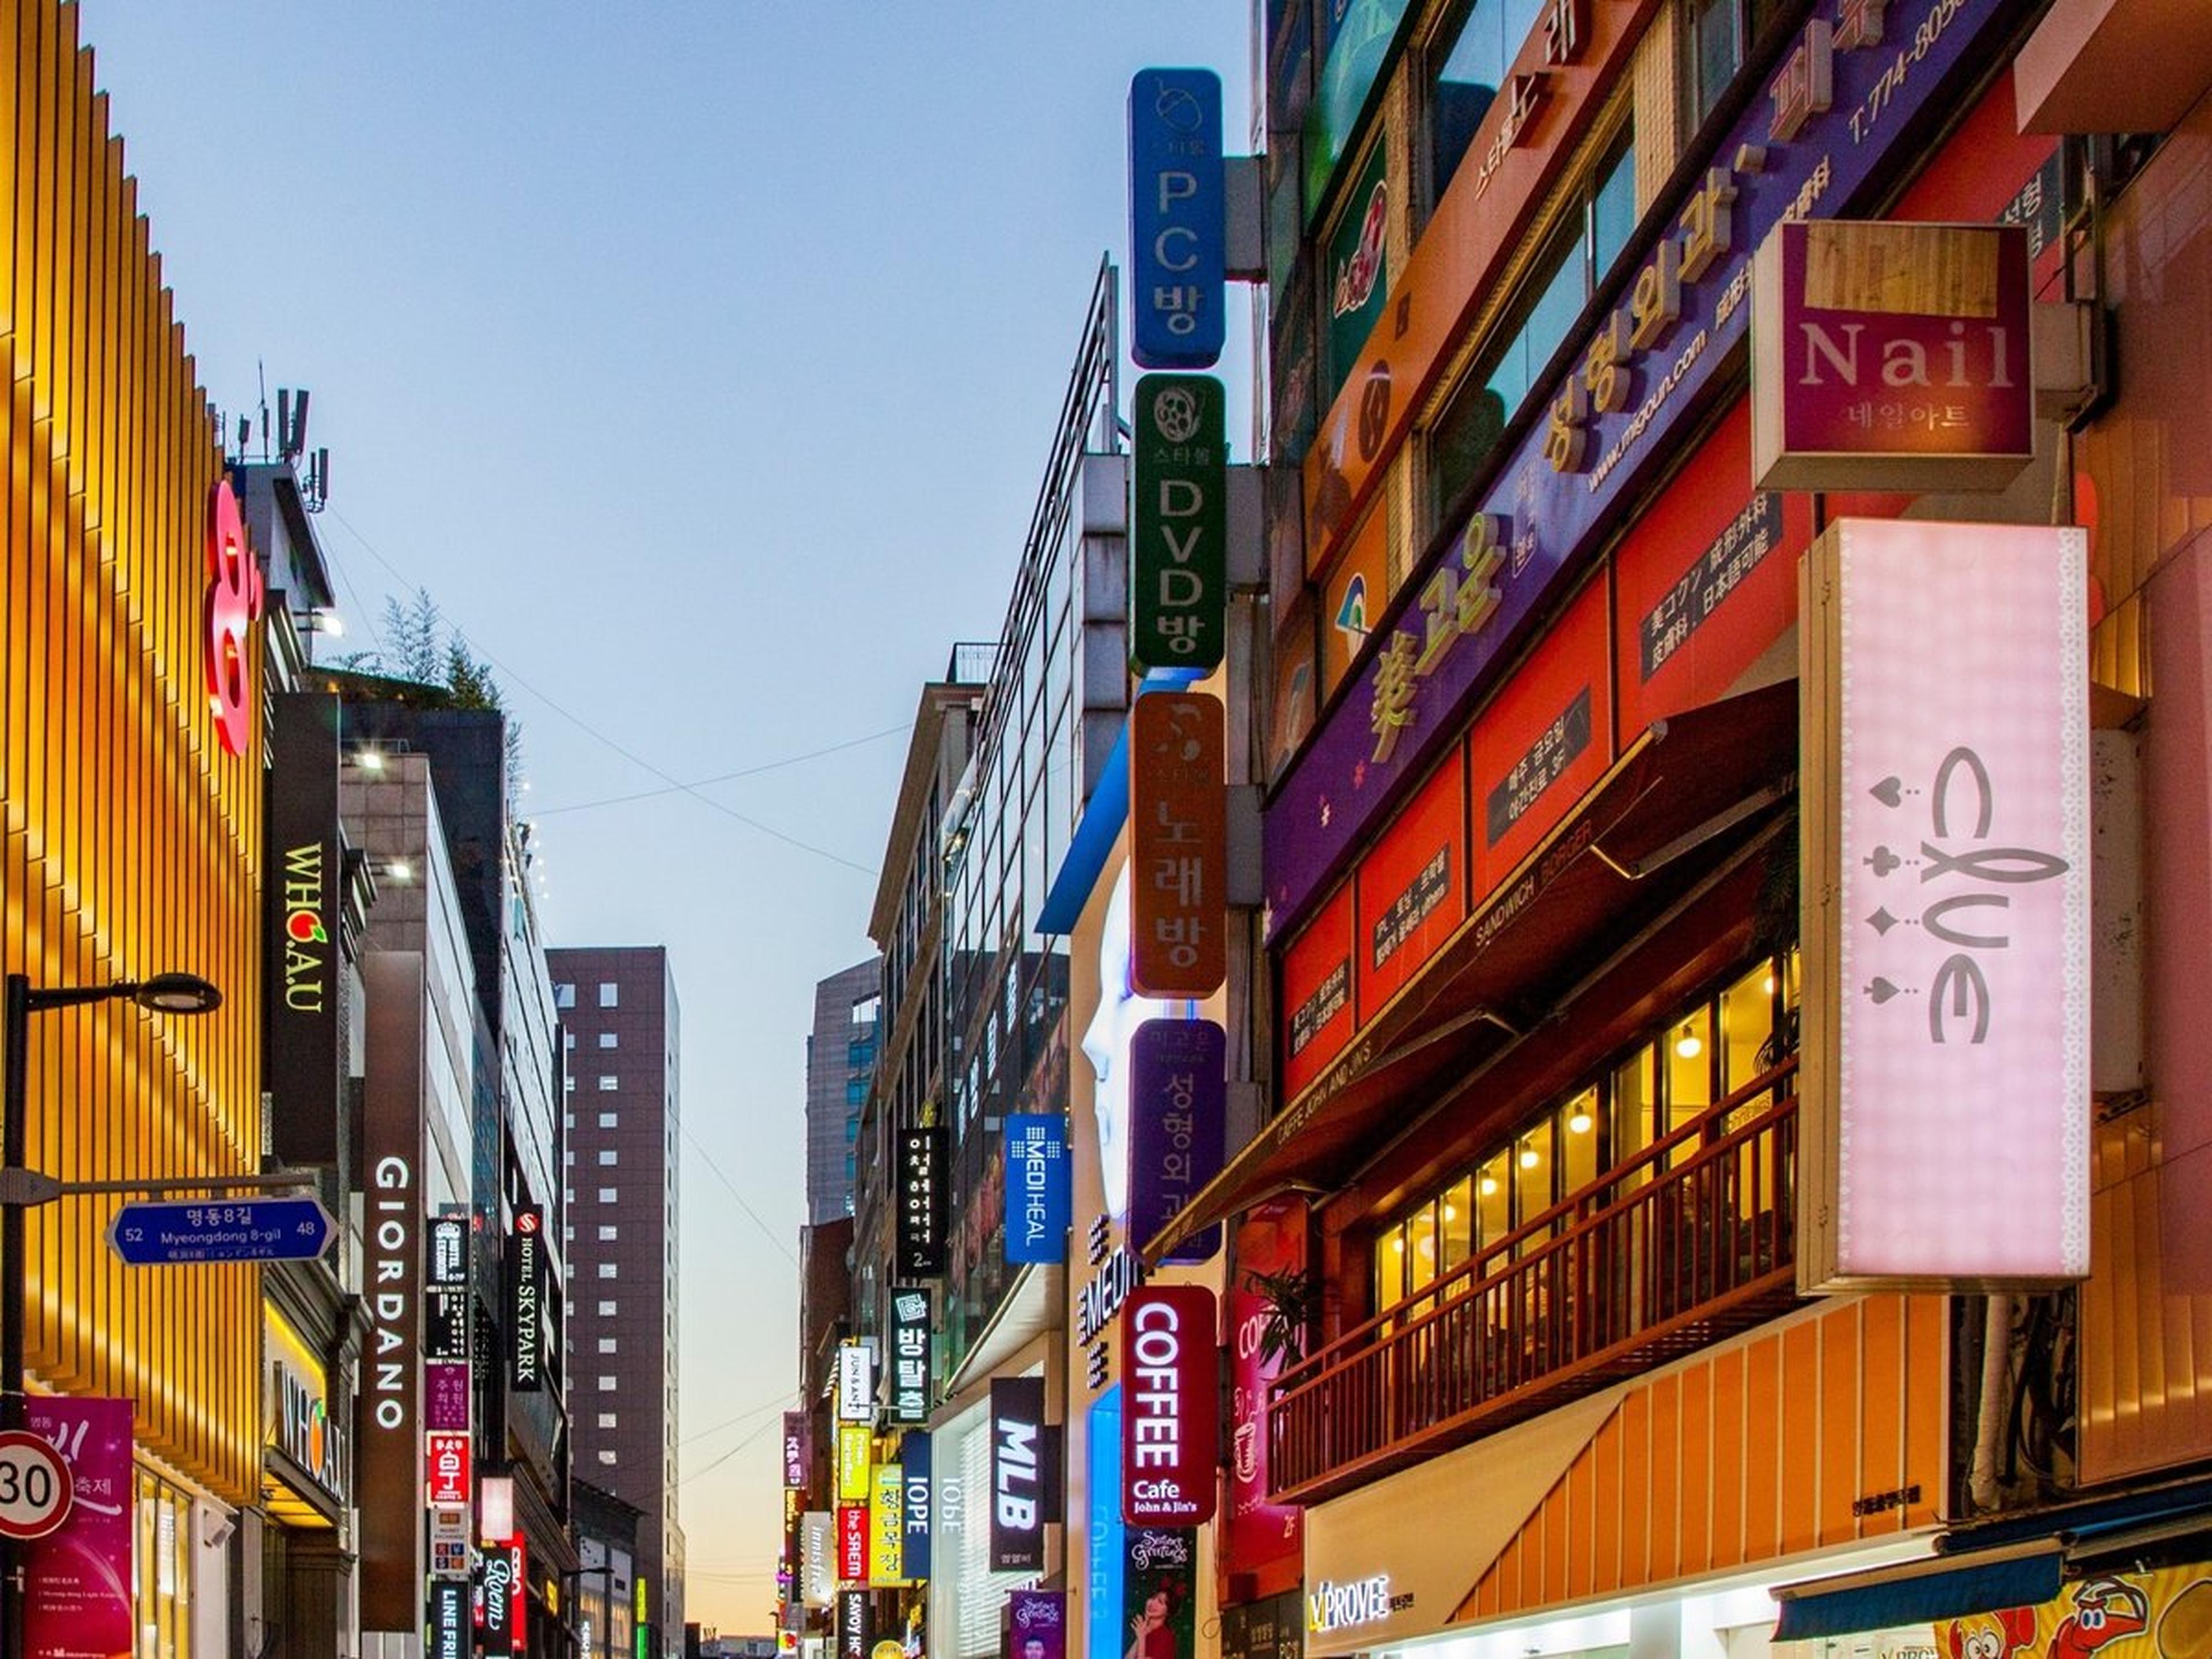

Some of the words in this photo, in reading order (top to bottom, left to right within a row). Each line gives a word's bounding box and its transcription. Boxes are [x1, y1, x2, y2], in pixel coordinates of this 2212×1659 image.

[1154, 172, 1205, 335] PC방
[1798, 321, 2014, 388] Nail
[1589, 328, 1707, 493] www.migoun.com
[1847, 402, 1969, 430] 네일아트
[1157, 480, 1205, 654] DVD방
[1154, 801, 1207, 968] 노래방
[1476, 874, 1534, 947] SANDWICH
[187, 1206, 252, 1227] 명동8길
[1025, 1141, 1046, 1247] MEDIHEAL
[125, 1228, 143, 1242] 52
[161, 1231, 247, 1245] Myeongdong
[250, 1229, 281, 1244] 8-gil
[296, 1222, 315, 1236] 48
[521, 1237, 533, 1282] HOTEL
[376, 1156, 404, 1429] GIORDANO
[518, 1286, 536, 1382] SKYPARK
[1133, 1302, 1179, 1468] COFFEE
[0, 1461, 51, 1509] 30
[75, 1476, 112, 1497] 축제
[998, 1418, 1036, 1531] MLB
[1133, 1480, 1180, 1499] Cafe
[848, 1509, 861, 1530] the
[907, 1477, 929, 1534] IOPE
[1134, 1501, 1160, 1514] John
[1162, 1501, 1172, 1512] &
[1173, 1501, 1198, 1514] Jin's
[847, 1532, 861, 1577] SAEM
[442, 1589, 457, 1628] LINE
[484, 1559, 512, 1630] Roem
[847, 1593, 862, 1634] SAVOY
